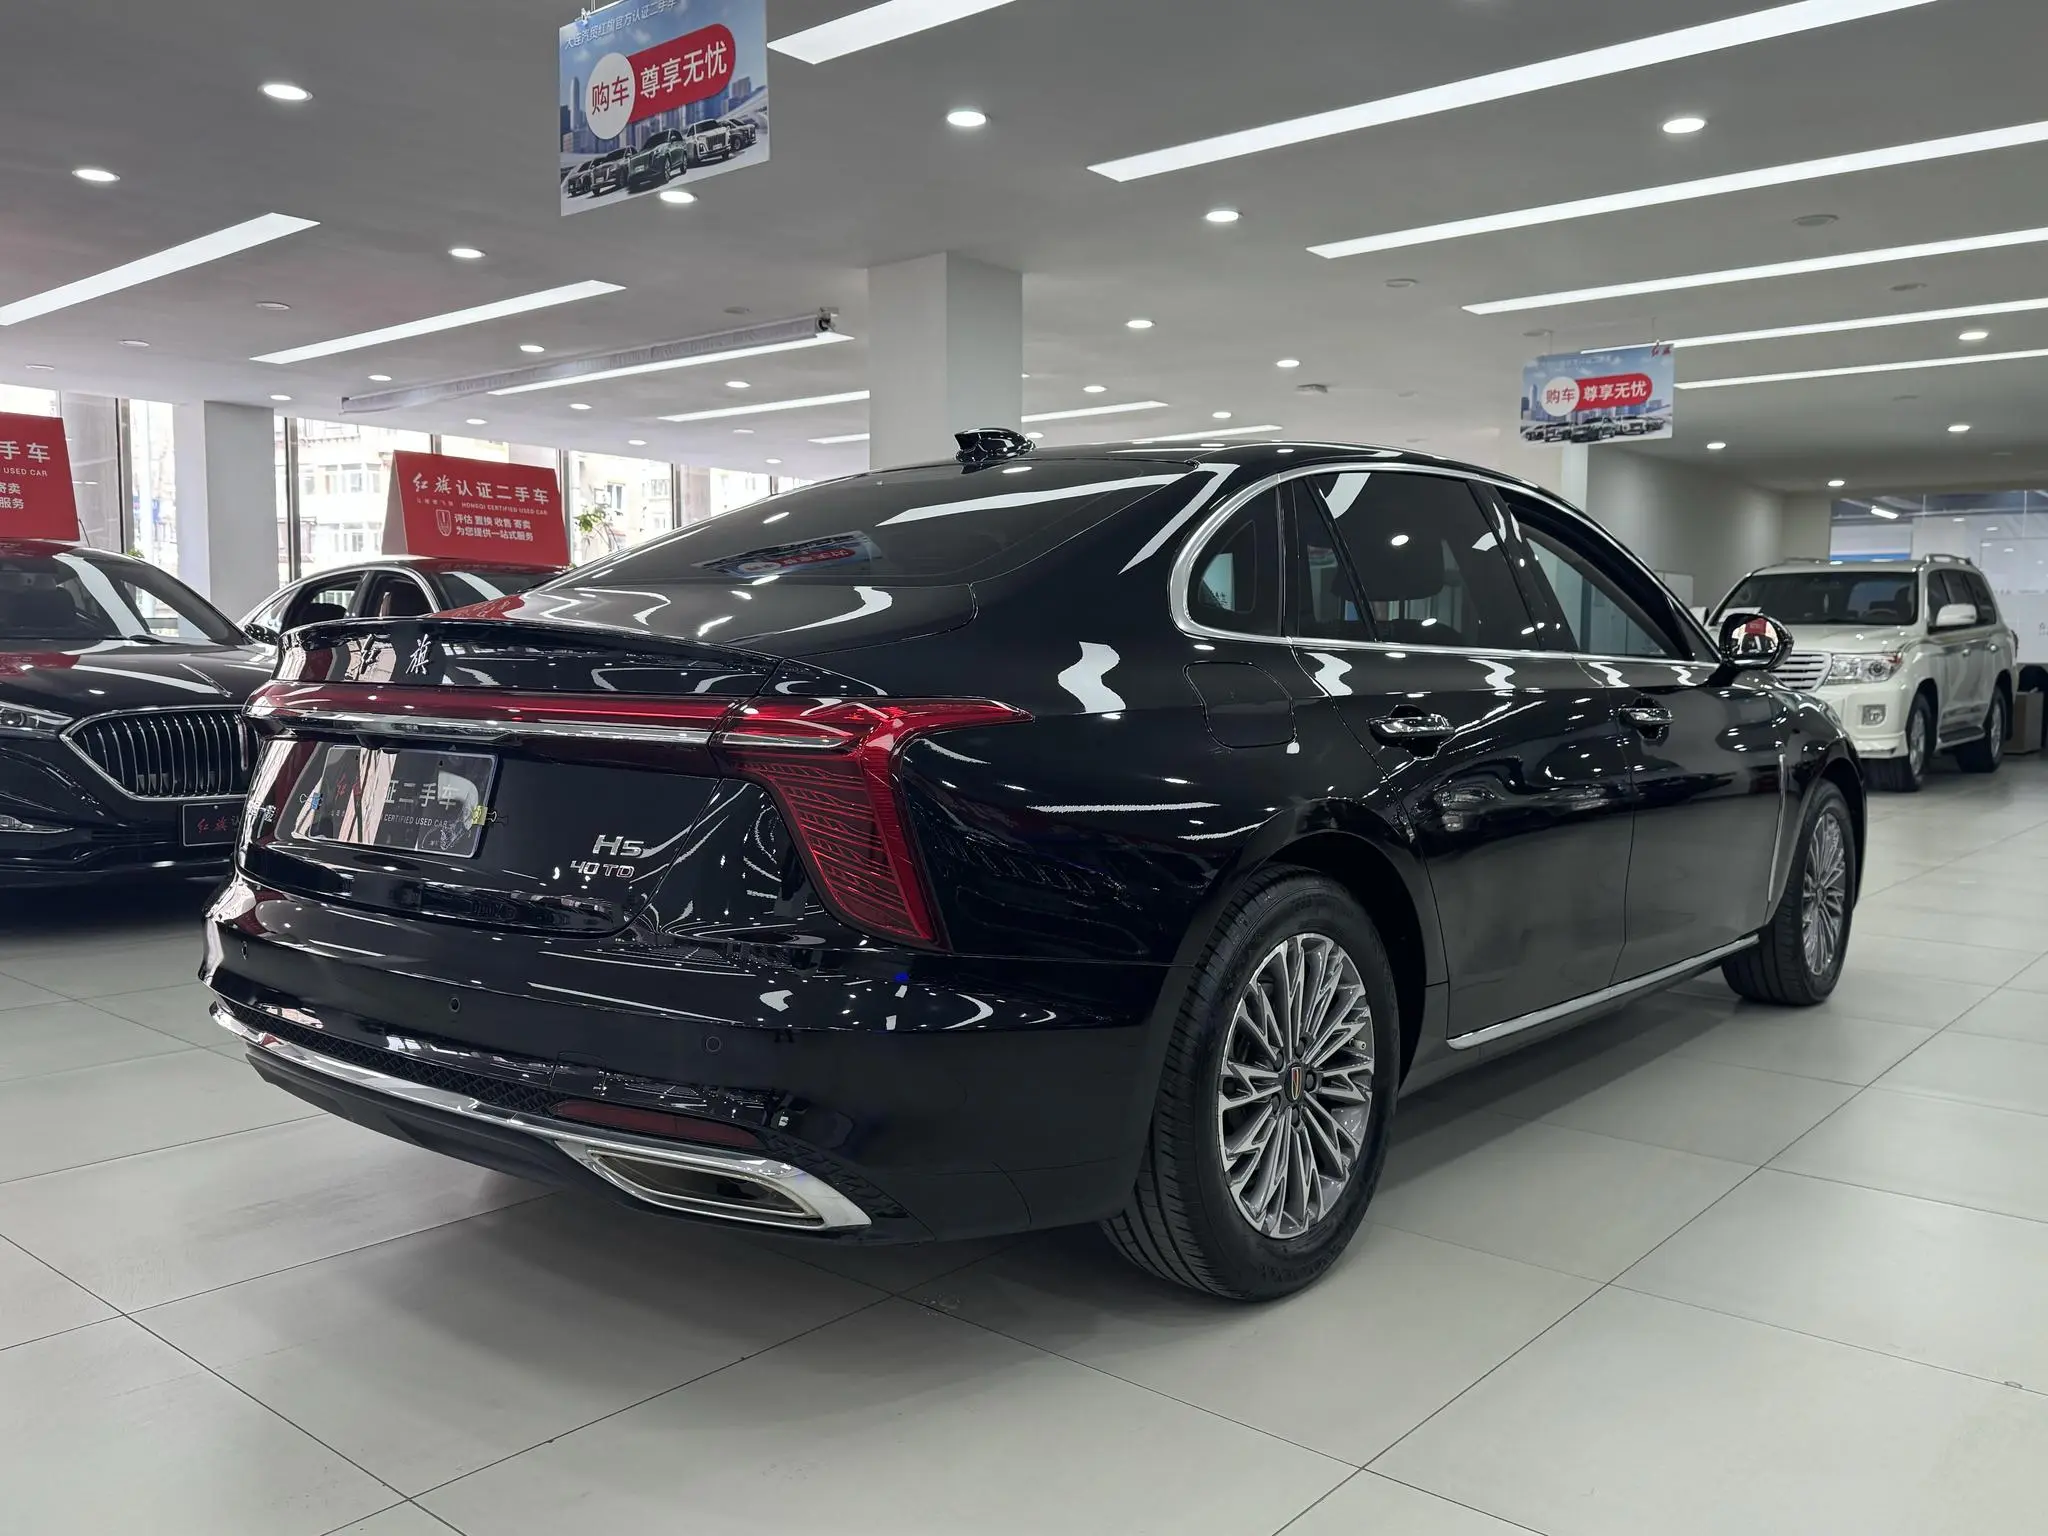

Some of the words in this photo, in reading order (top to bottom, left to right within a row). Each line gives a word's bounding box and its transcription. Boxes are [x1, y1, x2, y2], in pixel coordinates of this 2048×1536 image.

[592, 76, 629, 115] 购车
[640, 41, 727, 98] 尊享无忧
[1546, 386, 1575, 404] 购车
[1583, 381, 1647, 402] 尊享无忧
[3, 467, 27, 475] USED
[413, 472, 549, 504] 红旗认证二手车
[384, 814, 413, 825] CERTIFIED
[415, 817, 433, 826] USED
[434, 819, 448, 828] CAR
[592, 834, 644, 856] H5
